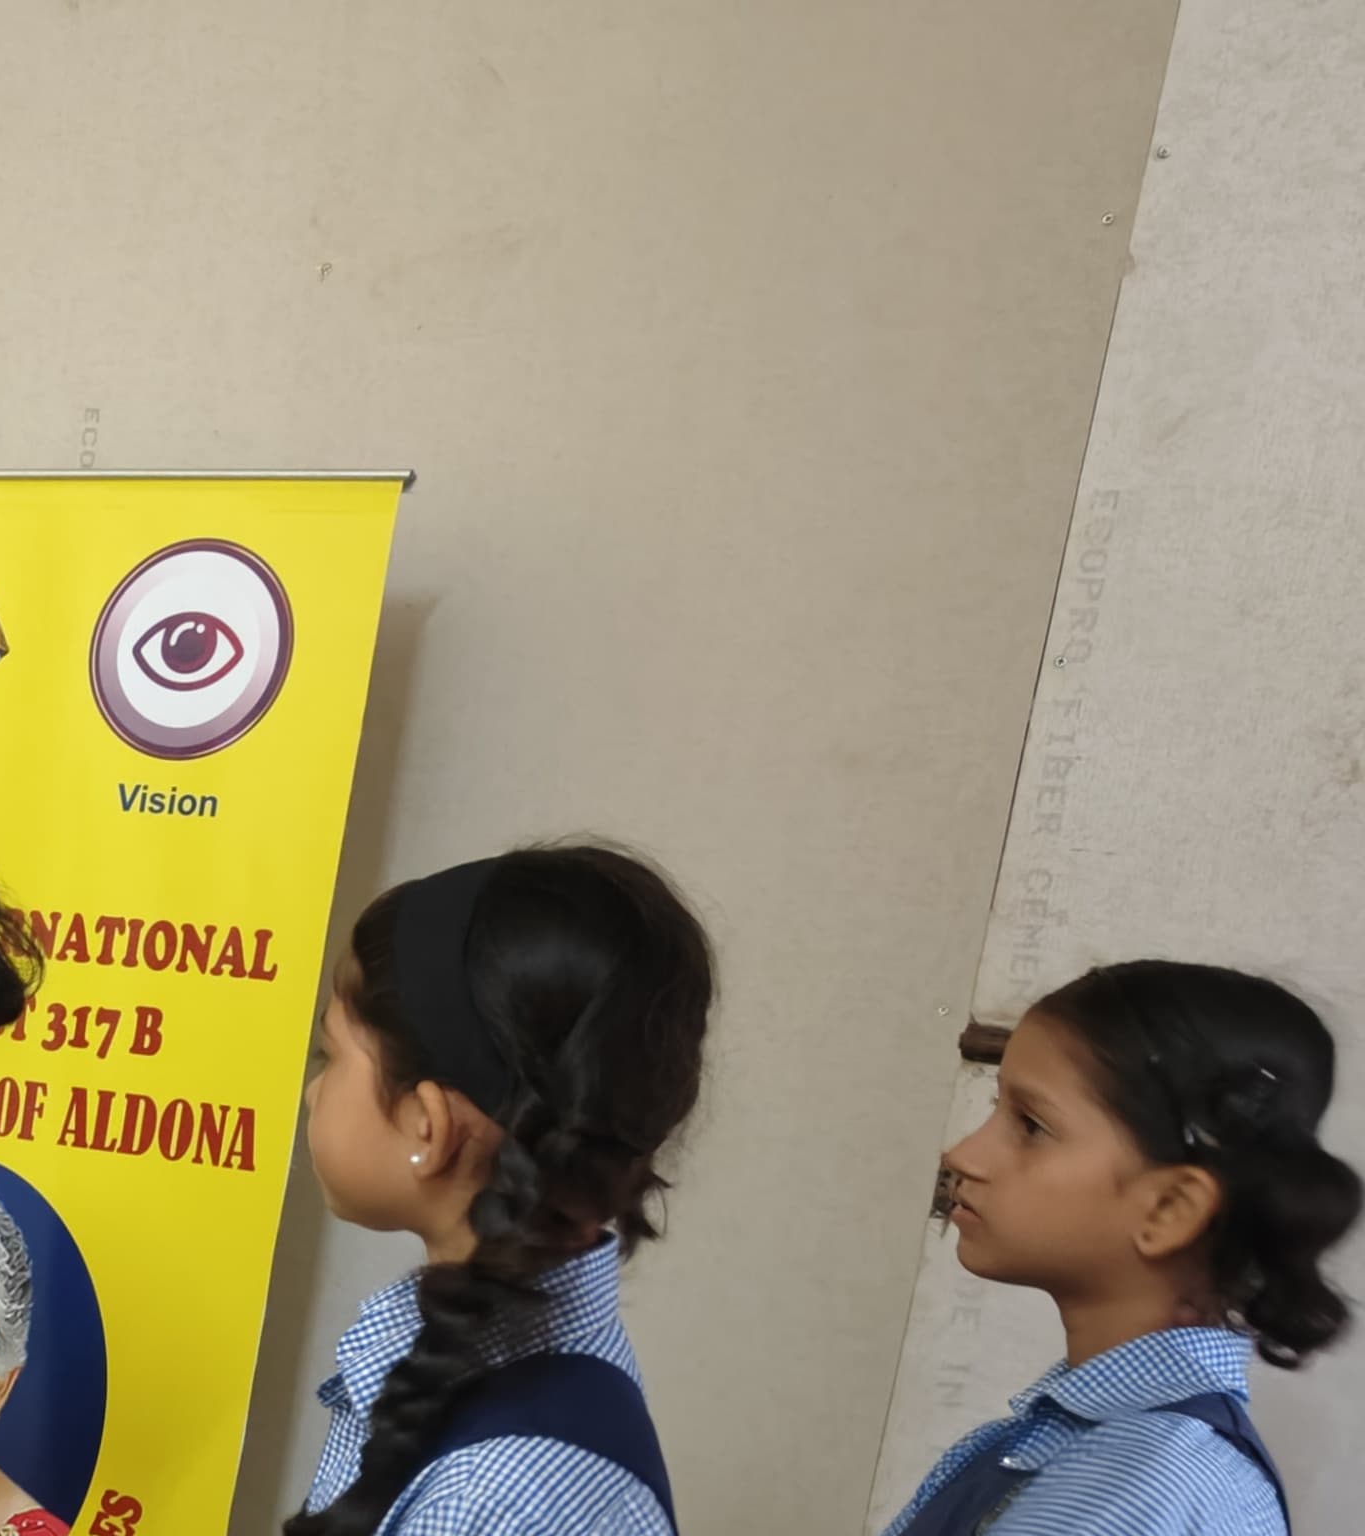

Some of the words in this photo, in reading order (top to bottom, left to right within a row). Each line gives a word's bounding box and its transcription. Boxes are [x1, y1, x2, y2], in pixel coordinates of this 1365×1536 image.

[117, 783, 219, 818] Vision
[1008, 869, 1054, 1000] CEMEN
[40, 1002, 122, 1060] 317
[129, 1006, 164, 1057] B
[56, 1086, 257, 1172] ALDONA
